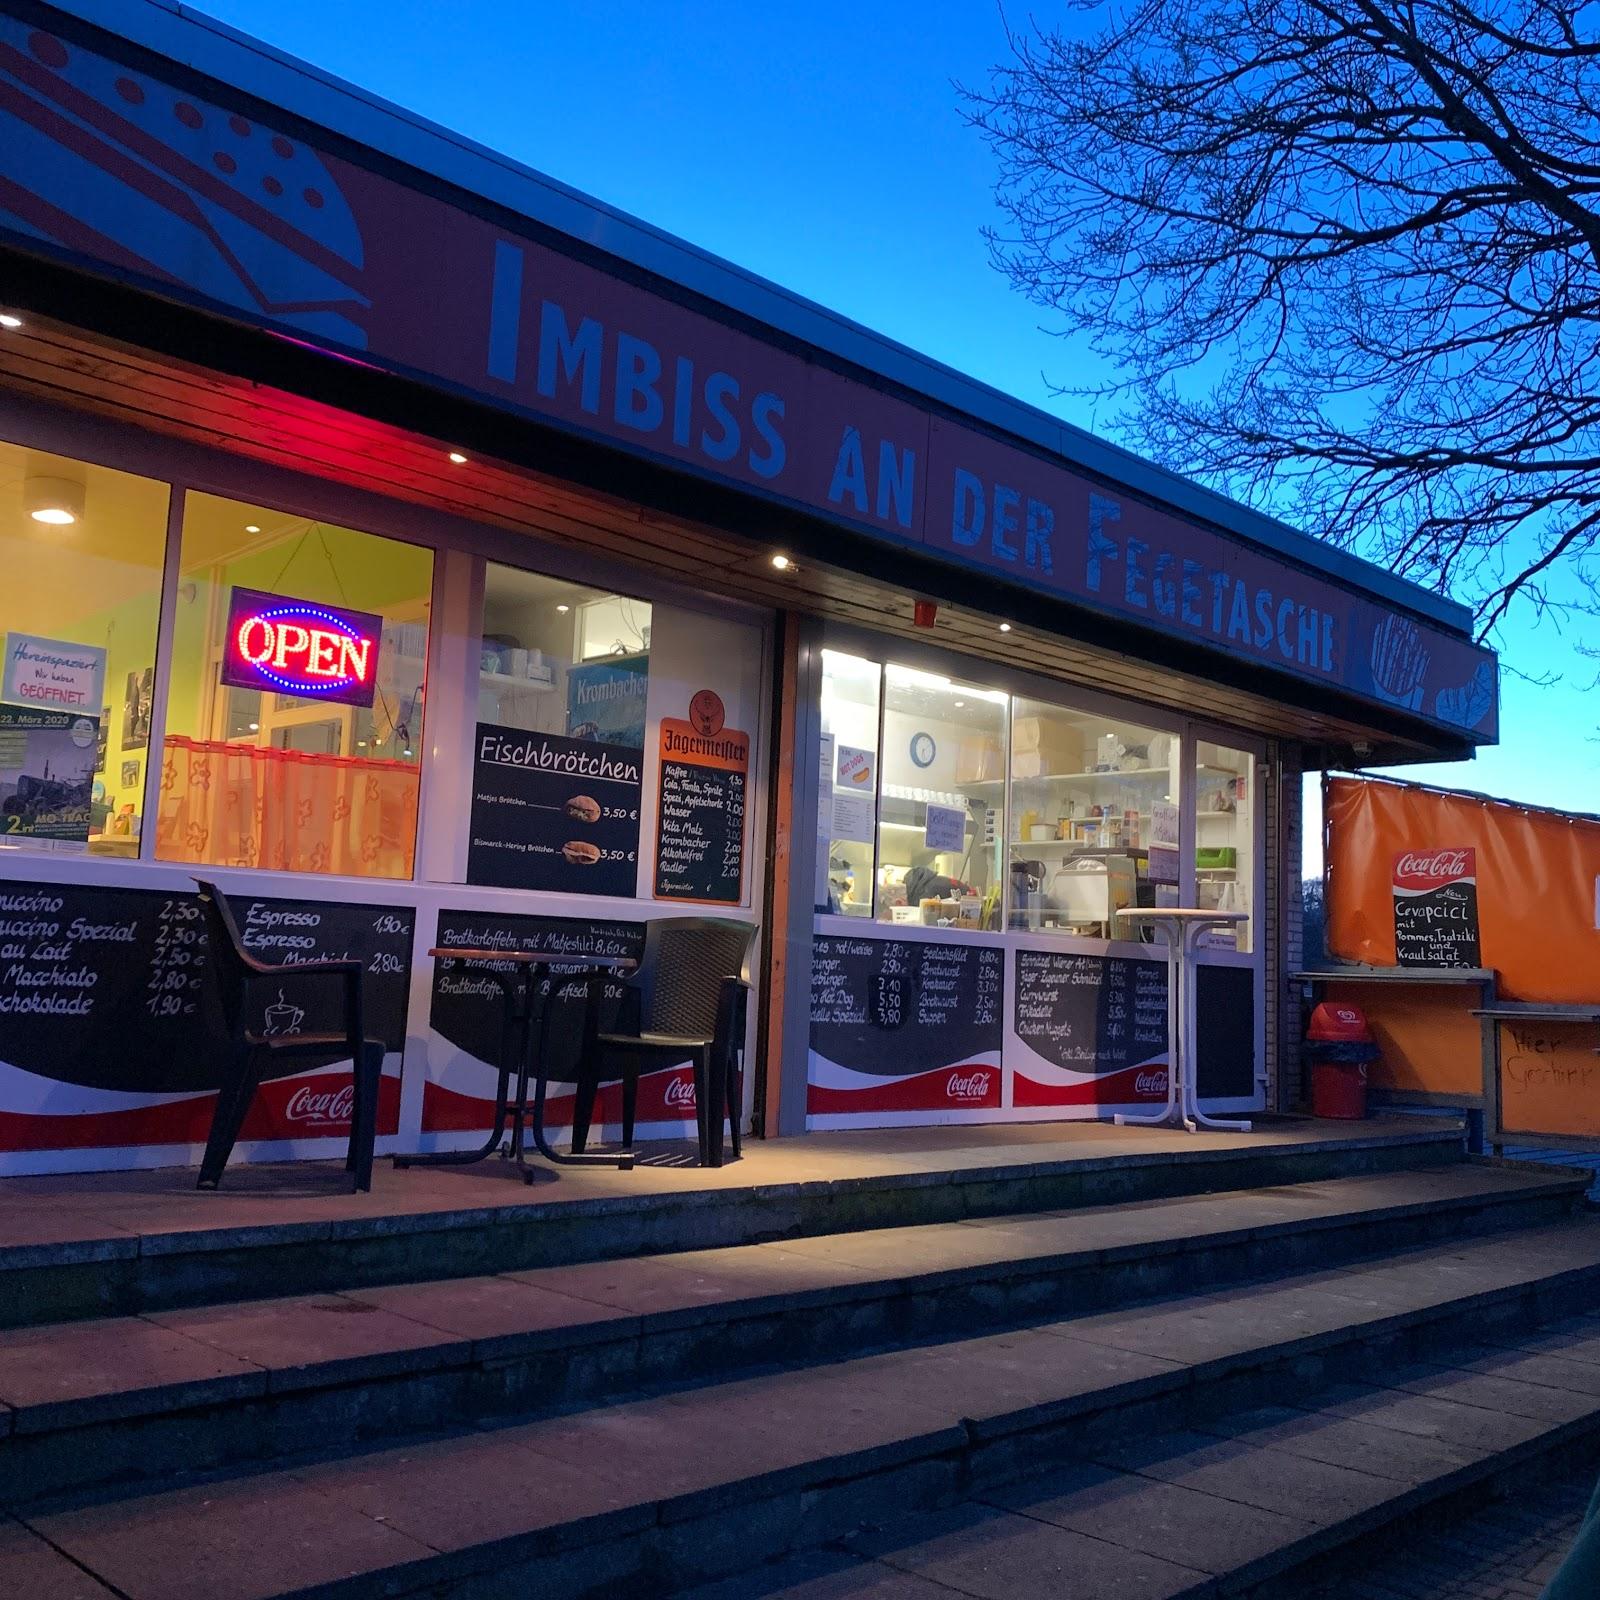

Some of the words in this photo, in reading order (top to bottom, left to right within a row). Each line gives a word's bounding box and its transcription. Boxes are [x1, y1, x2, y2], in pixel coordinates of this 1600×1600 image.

[827, 424, 916, 528] AN
[952, 467, 1055, 576] DER
[238, 615, 371, 682] OPEN
[35, 669, 48, 681] Wir
[51, 671, 75, 685] haben
[576, 671, 649, 704] Krombacher
[17, 715, 43, 724] März
[44, 715, 70, 725] 2020
[479, 735, 640, 781] Fischbrötchen
[665, 764, 688, 779] Kaffee
[602, 806, 627, 820] 3,50
[629, 809, 638, 821] €
[664, 804, 692, 817] Wasser
[662, 818, 681, 832] Vita
[681, 822, 704, 836] Malz
[661, 833, 712, 849] Krombacher
[600, 849, 625, 862] 3,50
[626, 851, 636, 862] €
[660, 846, 705, 863] Alkoholfrei
[659, 860, 689, 874] Radler
[1396, 850, 1470, 878] Coca-Cola
[245, 902, 321, 930] Espresso
[1395, 901, 1469, 923] Cevapcici
[66, 917, 138, 942] Spezial
[1397, 918, 1416, 928] mit
[240, 927, 317, 949] Espresso
[522, 936, 540, 949] mit
[1395, 930, 1437, 943] Pommes,
[0, 943, 26, 959] au
[1396, 946, 1461, 961] Krautsalat
[1429, 942, 1455, 950] und
[2, 963, 99, 988] Macchiato
[921, 961, 961, 977] Bratwurst
[819, 988, 836, 1004] Hot
[836, 989, 854, 1011] Dog
[879, 991, 901, 1009] 5,50
[832, 1007, 866, 1027] Spezial
[877, 1007, 901, 1025] 3,80
[946, 1072, 992, 1097] Coca-Cola
